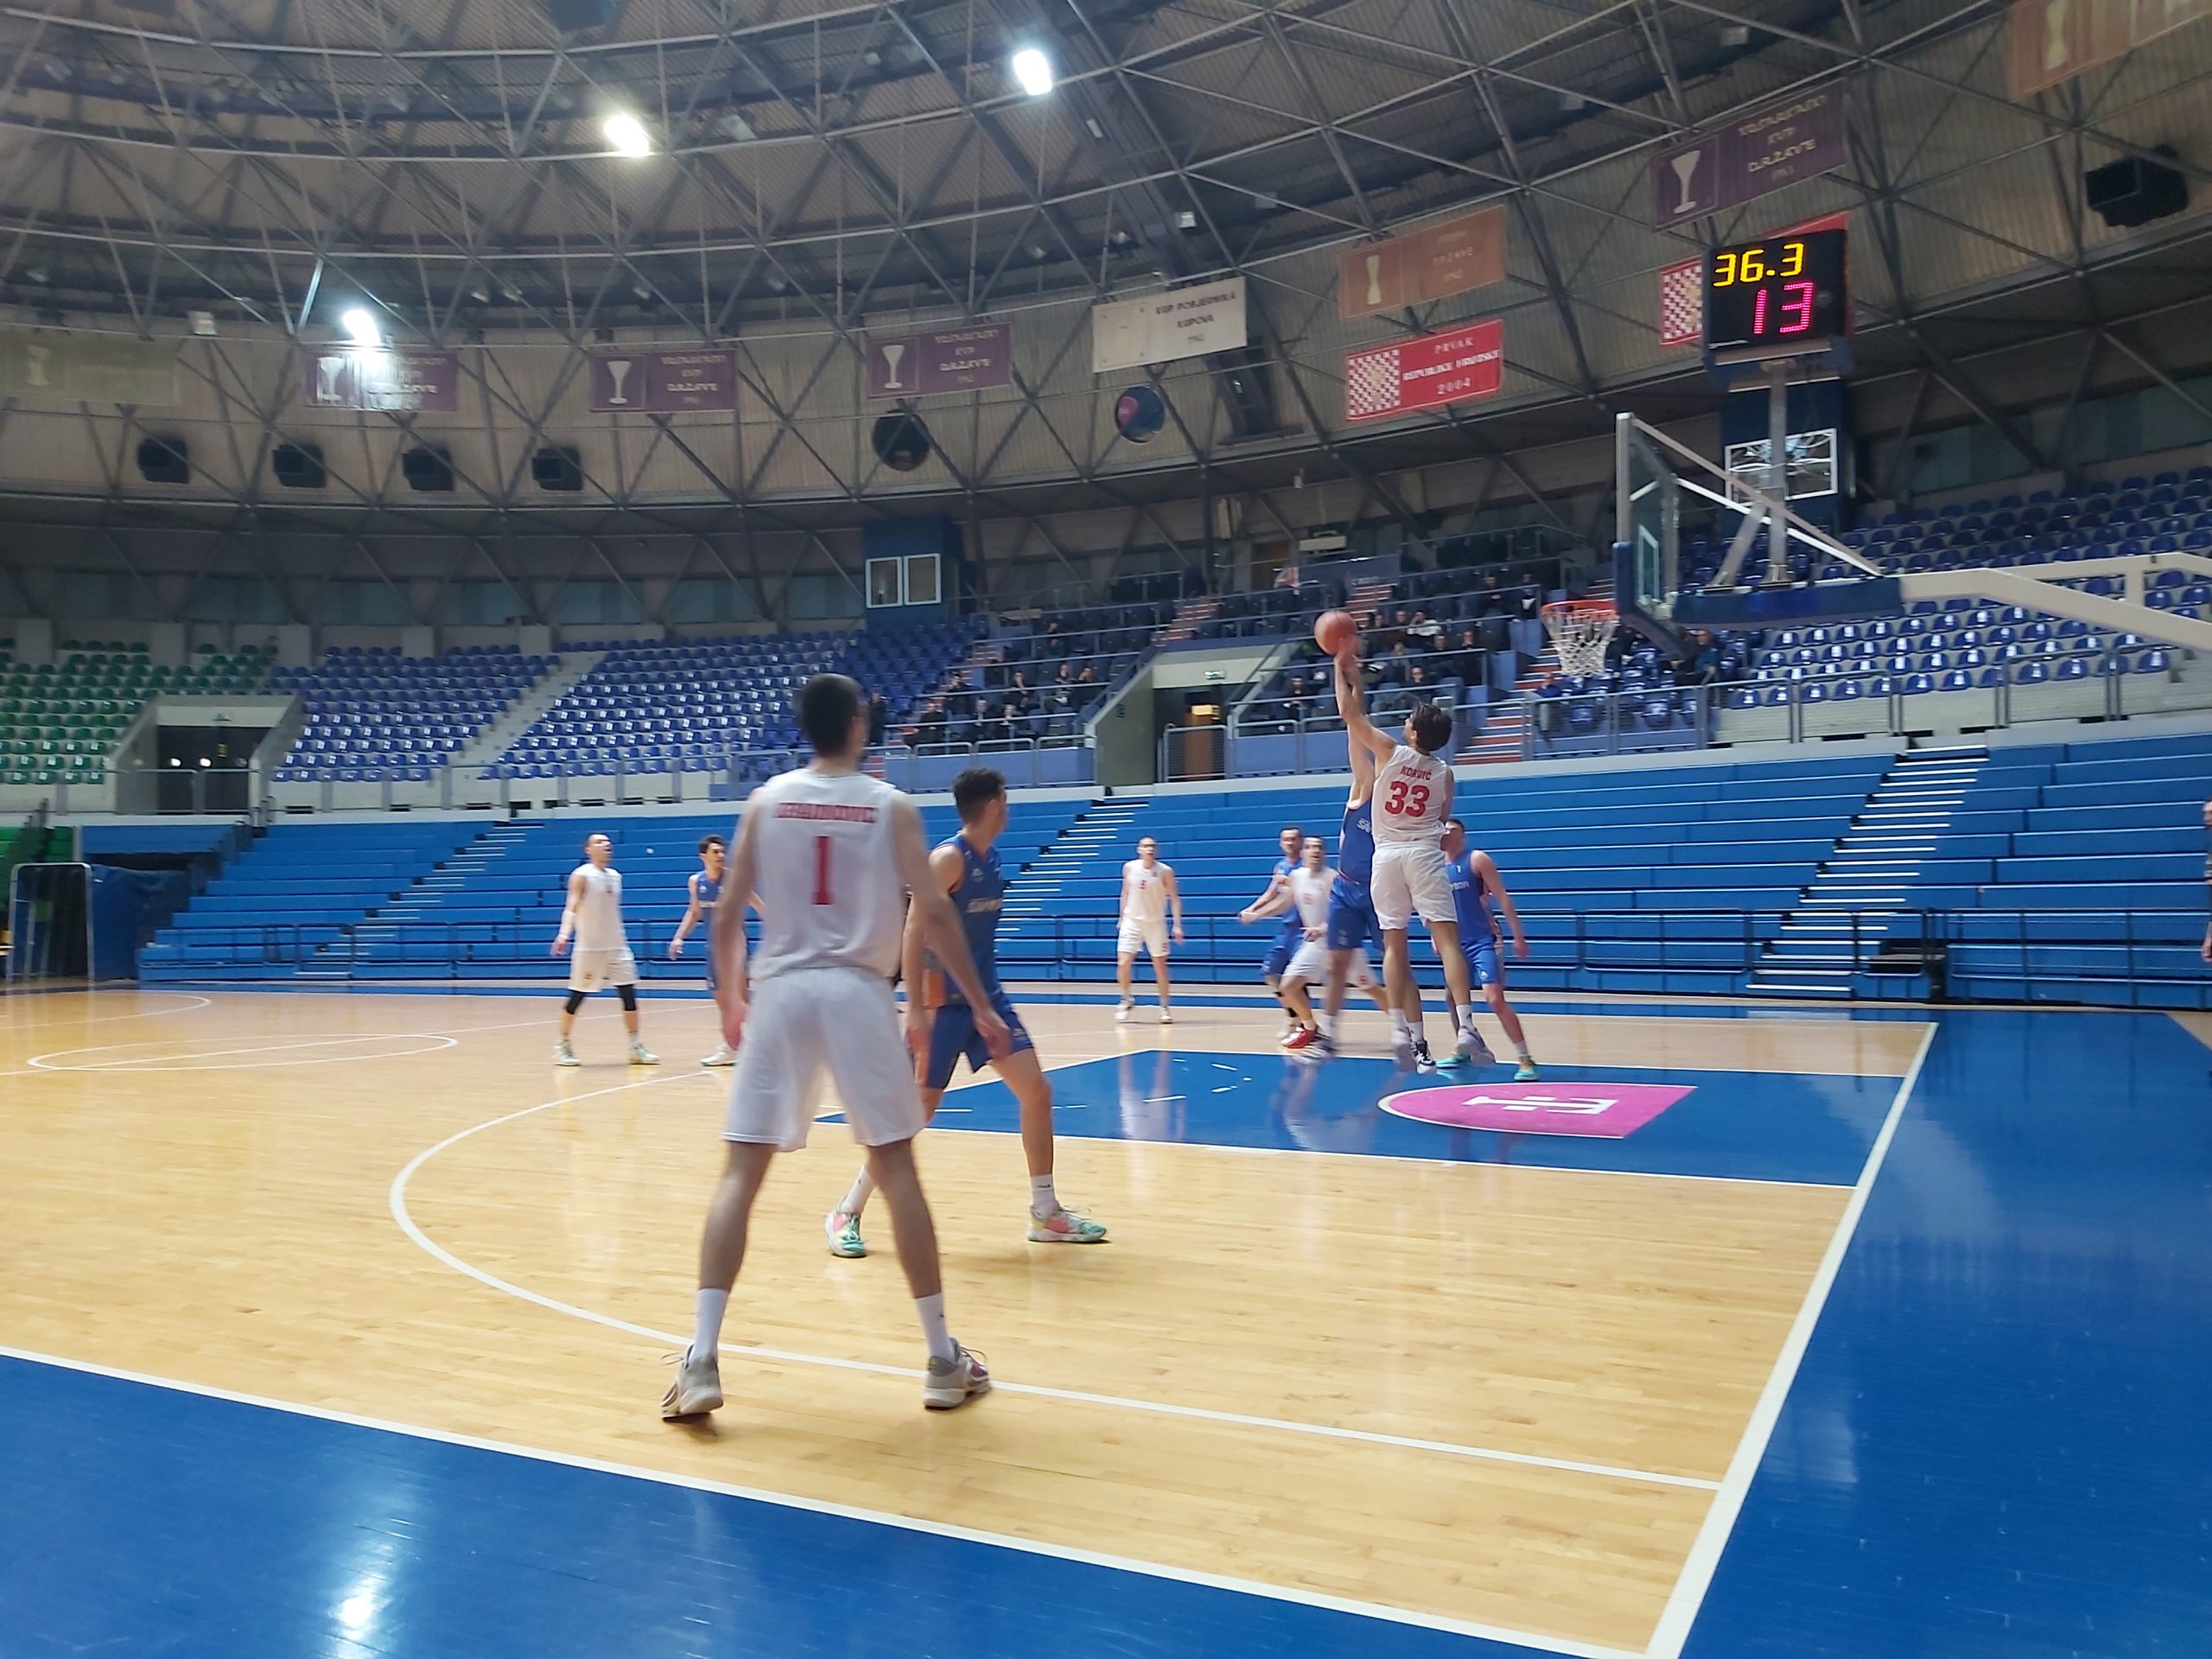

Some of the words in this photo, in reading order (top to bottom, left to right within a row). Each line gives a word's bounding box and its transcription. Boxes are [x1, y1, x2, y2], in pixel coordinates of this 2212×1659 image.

[1713, 242, 1804, 287] 36.3
[1752, 281, 1814, 335] 13
[1384, 780, 1430, 817] 33
[810, 836, 836, 905] 1
